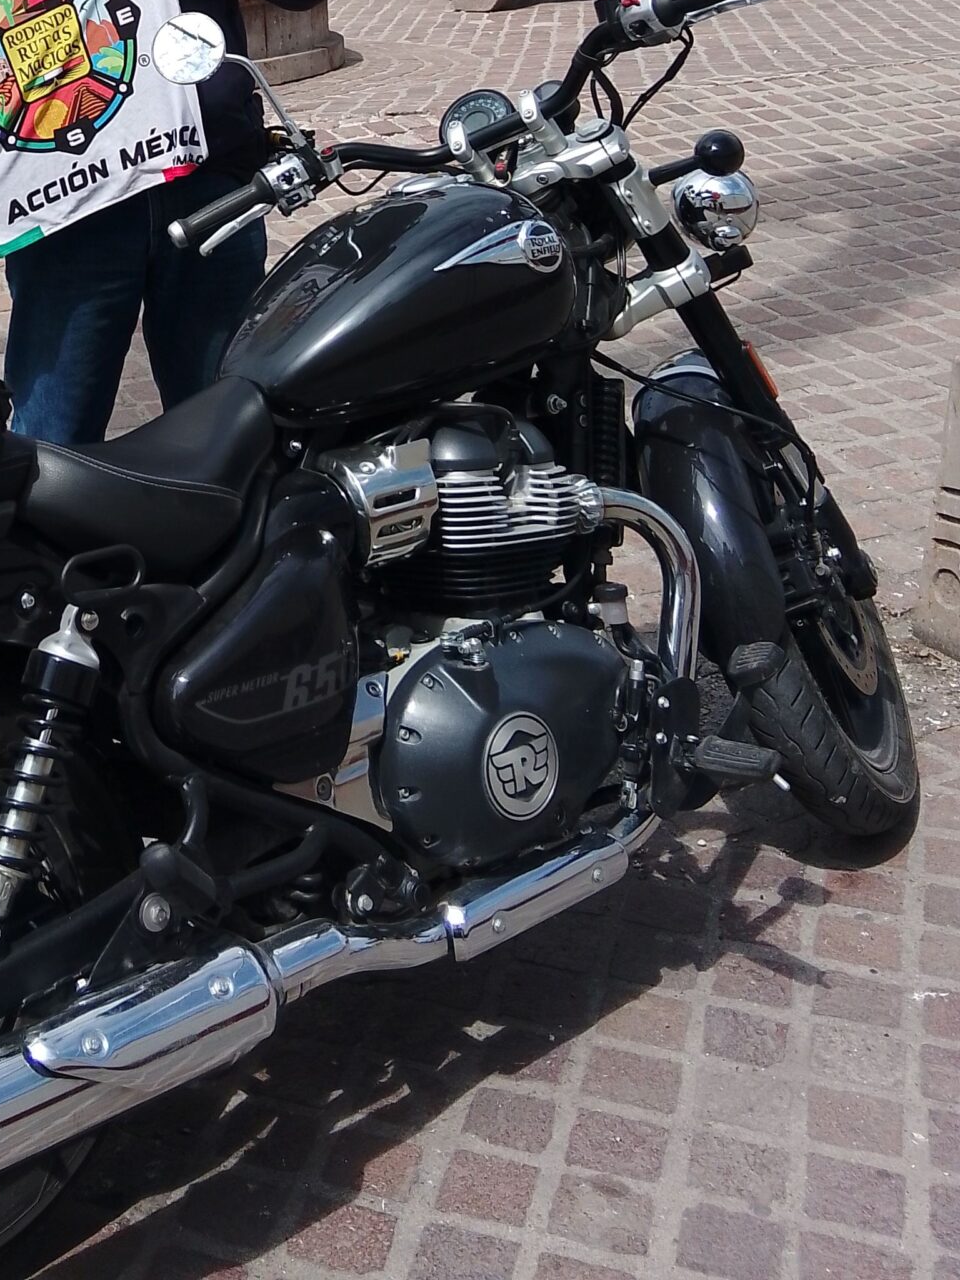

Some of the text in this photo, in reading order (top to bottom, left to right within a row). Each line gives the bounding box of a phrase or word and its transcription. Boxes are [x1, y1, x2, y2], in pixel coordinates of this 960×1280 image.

[116, 6, 135, 26] E
[66, 128, 86, 147] S
[7, 160, 110, 225] ACCIÓN
[530, 235, 557, 247] ROYAL
[206, 686, 238, 704] SUPER
[241, 672, 280, 692] METEOR
